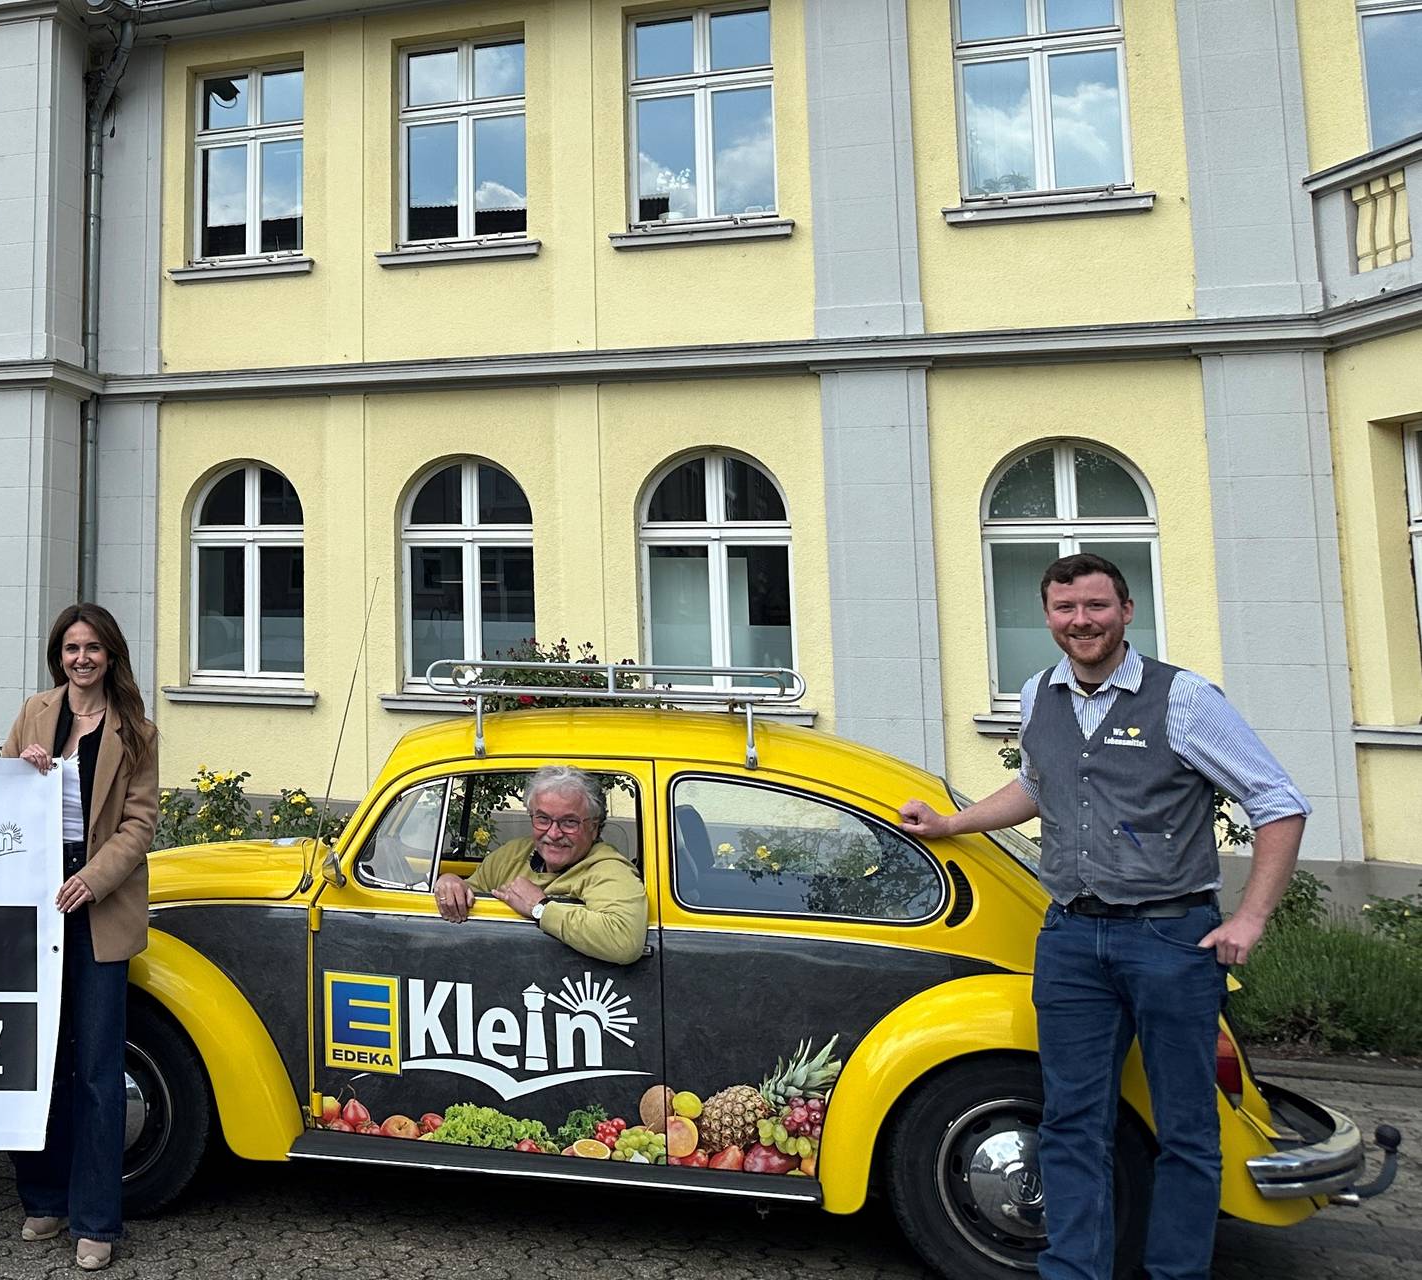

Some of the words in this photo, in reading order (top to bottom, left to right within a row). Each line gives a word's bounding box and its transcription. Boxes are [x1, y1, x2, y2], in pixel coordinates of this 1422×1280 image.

[1112, 727, 1125, 736] Wir
[408, 977, 604, 1072] Klein
[331, 1048, 394, 1068] EDEKA
